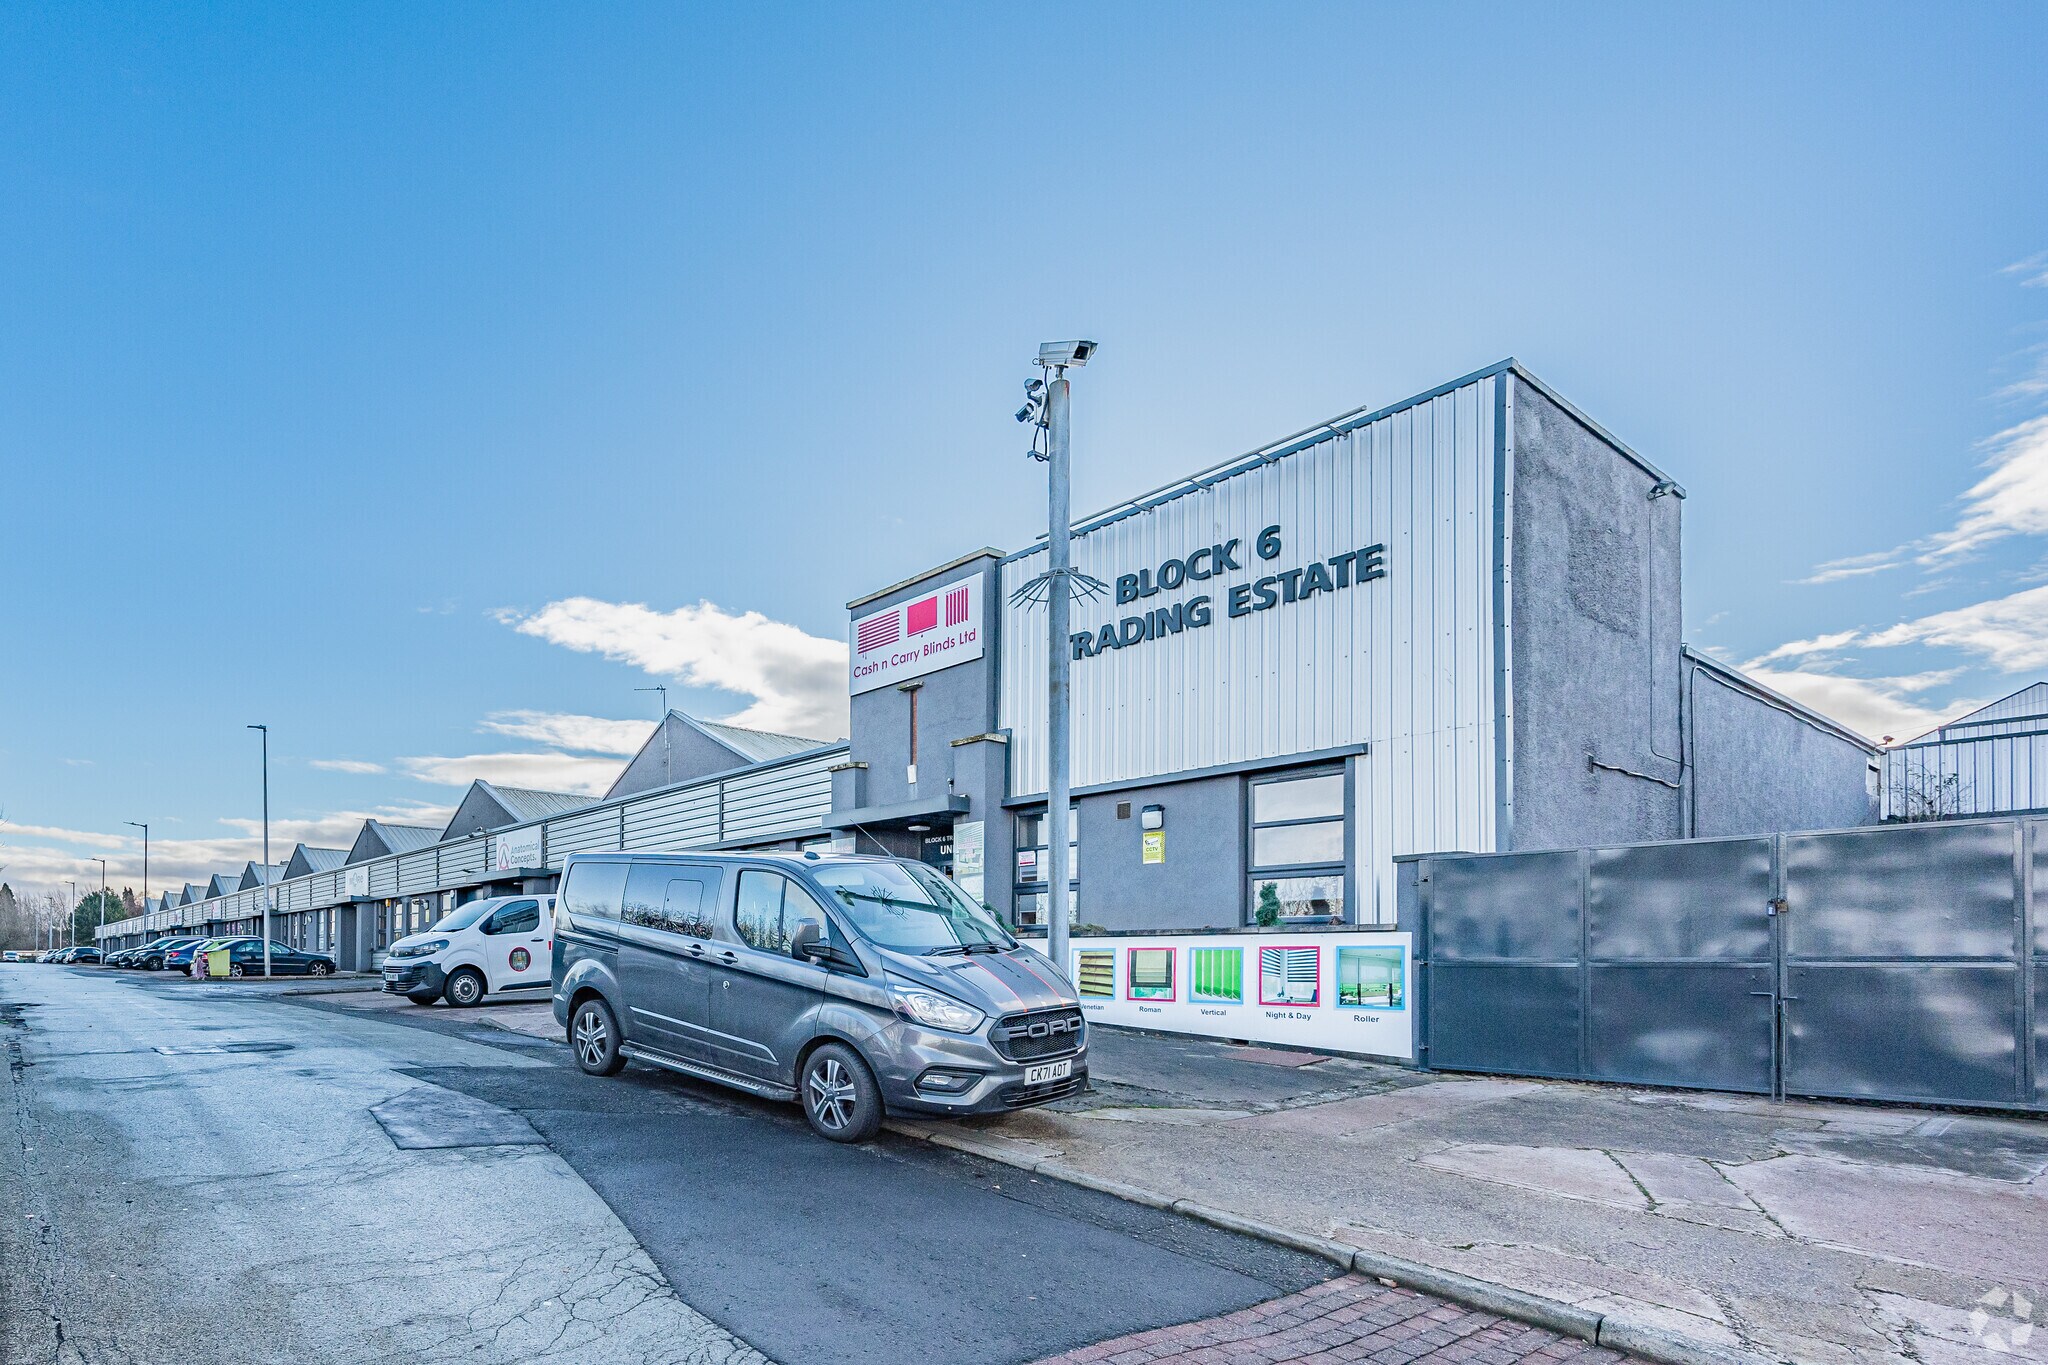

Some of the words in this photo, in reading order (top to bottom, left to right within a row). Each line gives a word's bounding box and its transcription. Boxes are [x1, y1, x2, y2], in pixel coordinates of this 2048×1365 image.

[1116, 538, 1242, 606] BLOCK
[1256, 525, 1281, 561] 6
[1070, 595, 1212, 661] RADING
[1228, 543, 1388, 619] ESTATE
[853, 661, 879, 678] Cash
[881, 660, 888, 670] n
[891, 649, 920, 666] Carry
[923, 637, 956, 657] Blinds
[959, 628, 976, 645] Ltd
[940, 845, 953, 855] UN
[1139, 1005, 1162, 1013] Roman
[1200, 1008, 1227, 1016] Vertical
[1265, 1011, 1286, 1019] Night
[1296, 1013, 1312, 1021] Day
[1353, 1014, 1380, 1023] Roller
[1007, 1015, 1082, 1041] FORD
[1030, 1067, 1051, 1082] CK71
